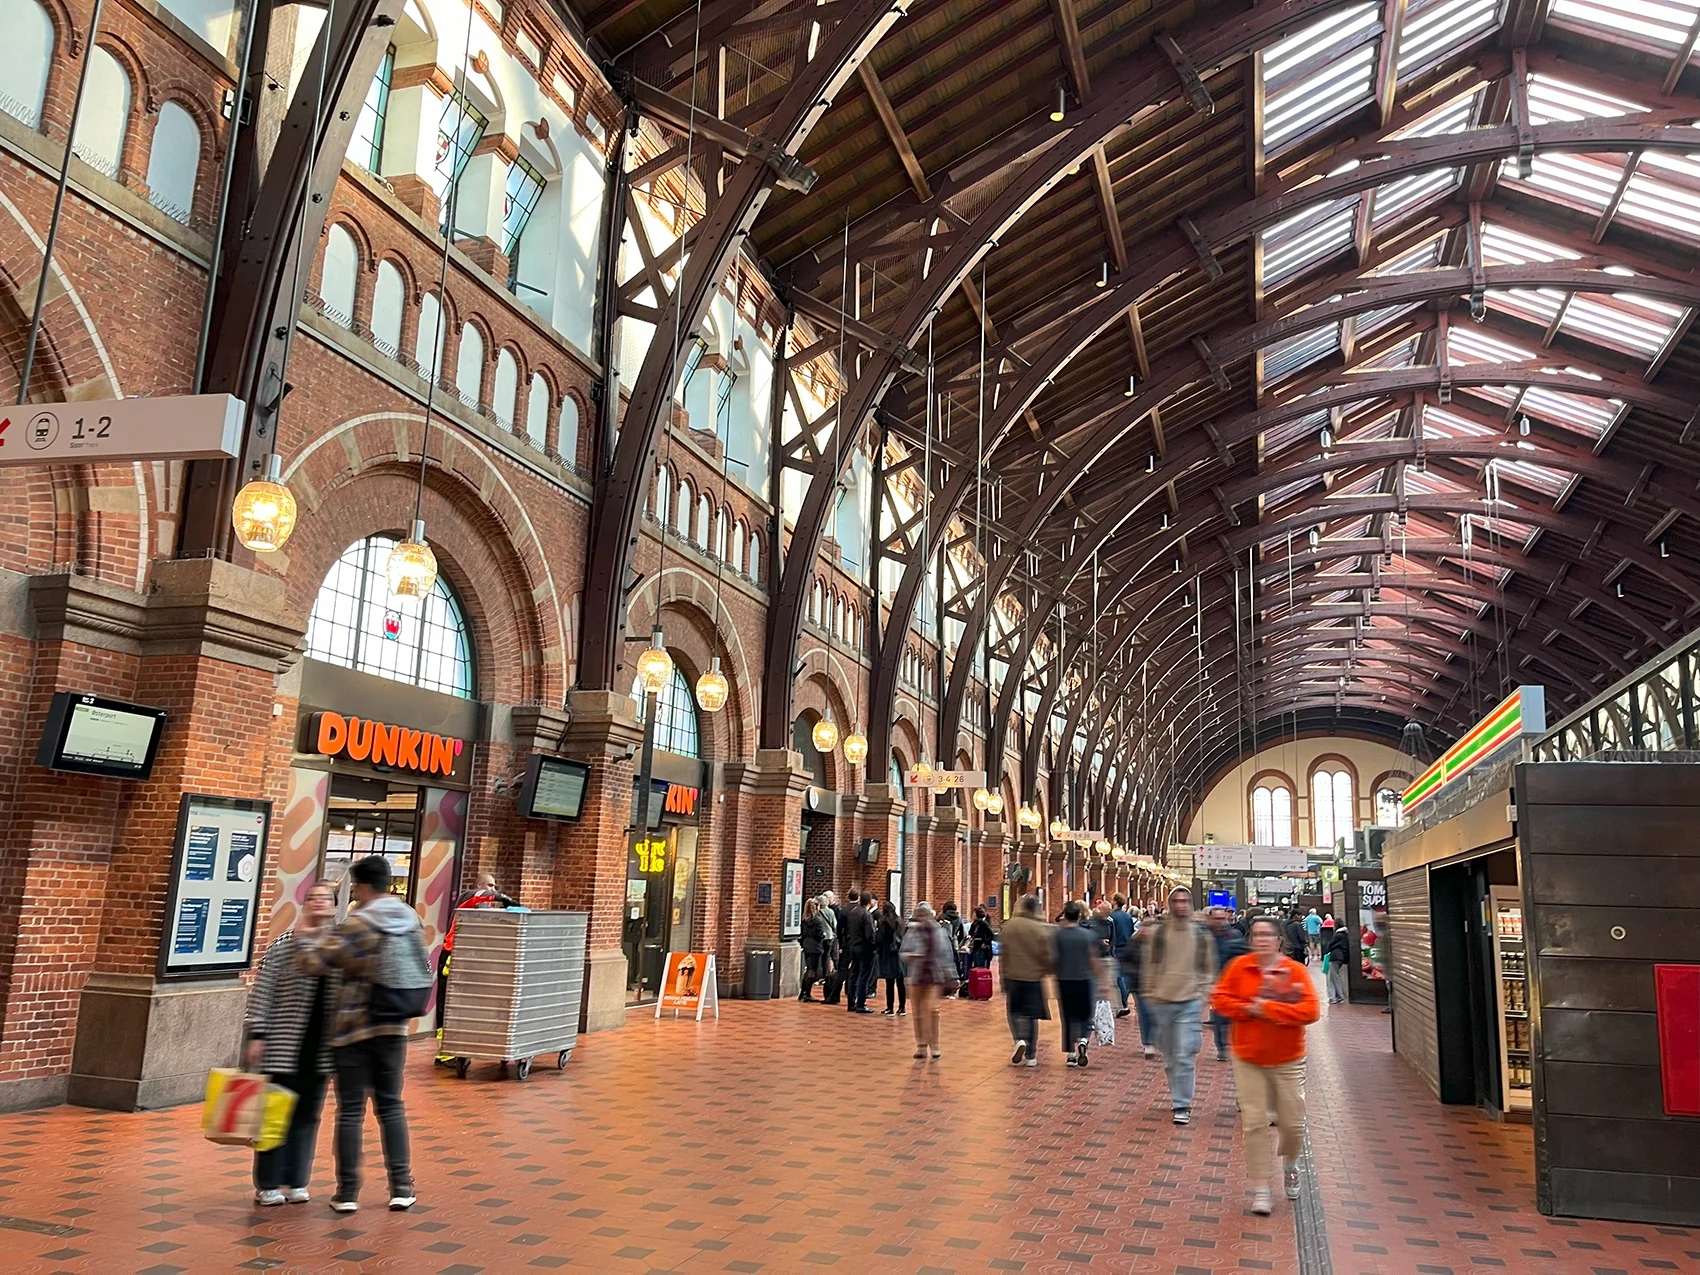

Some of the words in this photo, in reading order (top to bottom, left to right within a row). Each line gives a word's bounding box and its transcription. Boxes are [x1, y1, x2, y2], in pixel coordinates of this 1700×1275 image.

[72, 416, 113, 440] 1-2
[318, 712, 462, 775] DUNKIN'
[938, 775, 951, 783] 3-4
[665, 783, 699, 815] KIN'
[1361, 884, 1386, 895] TOM
